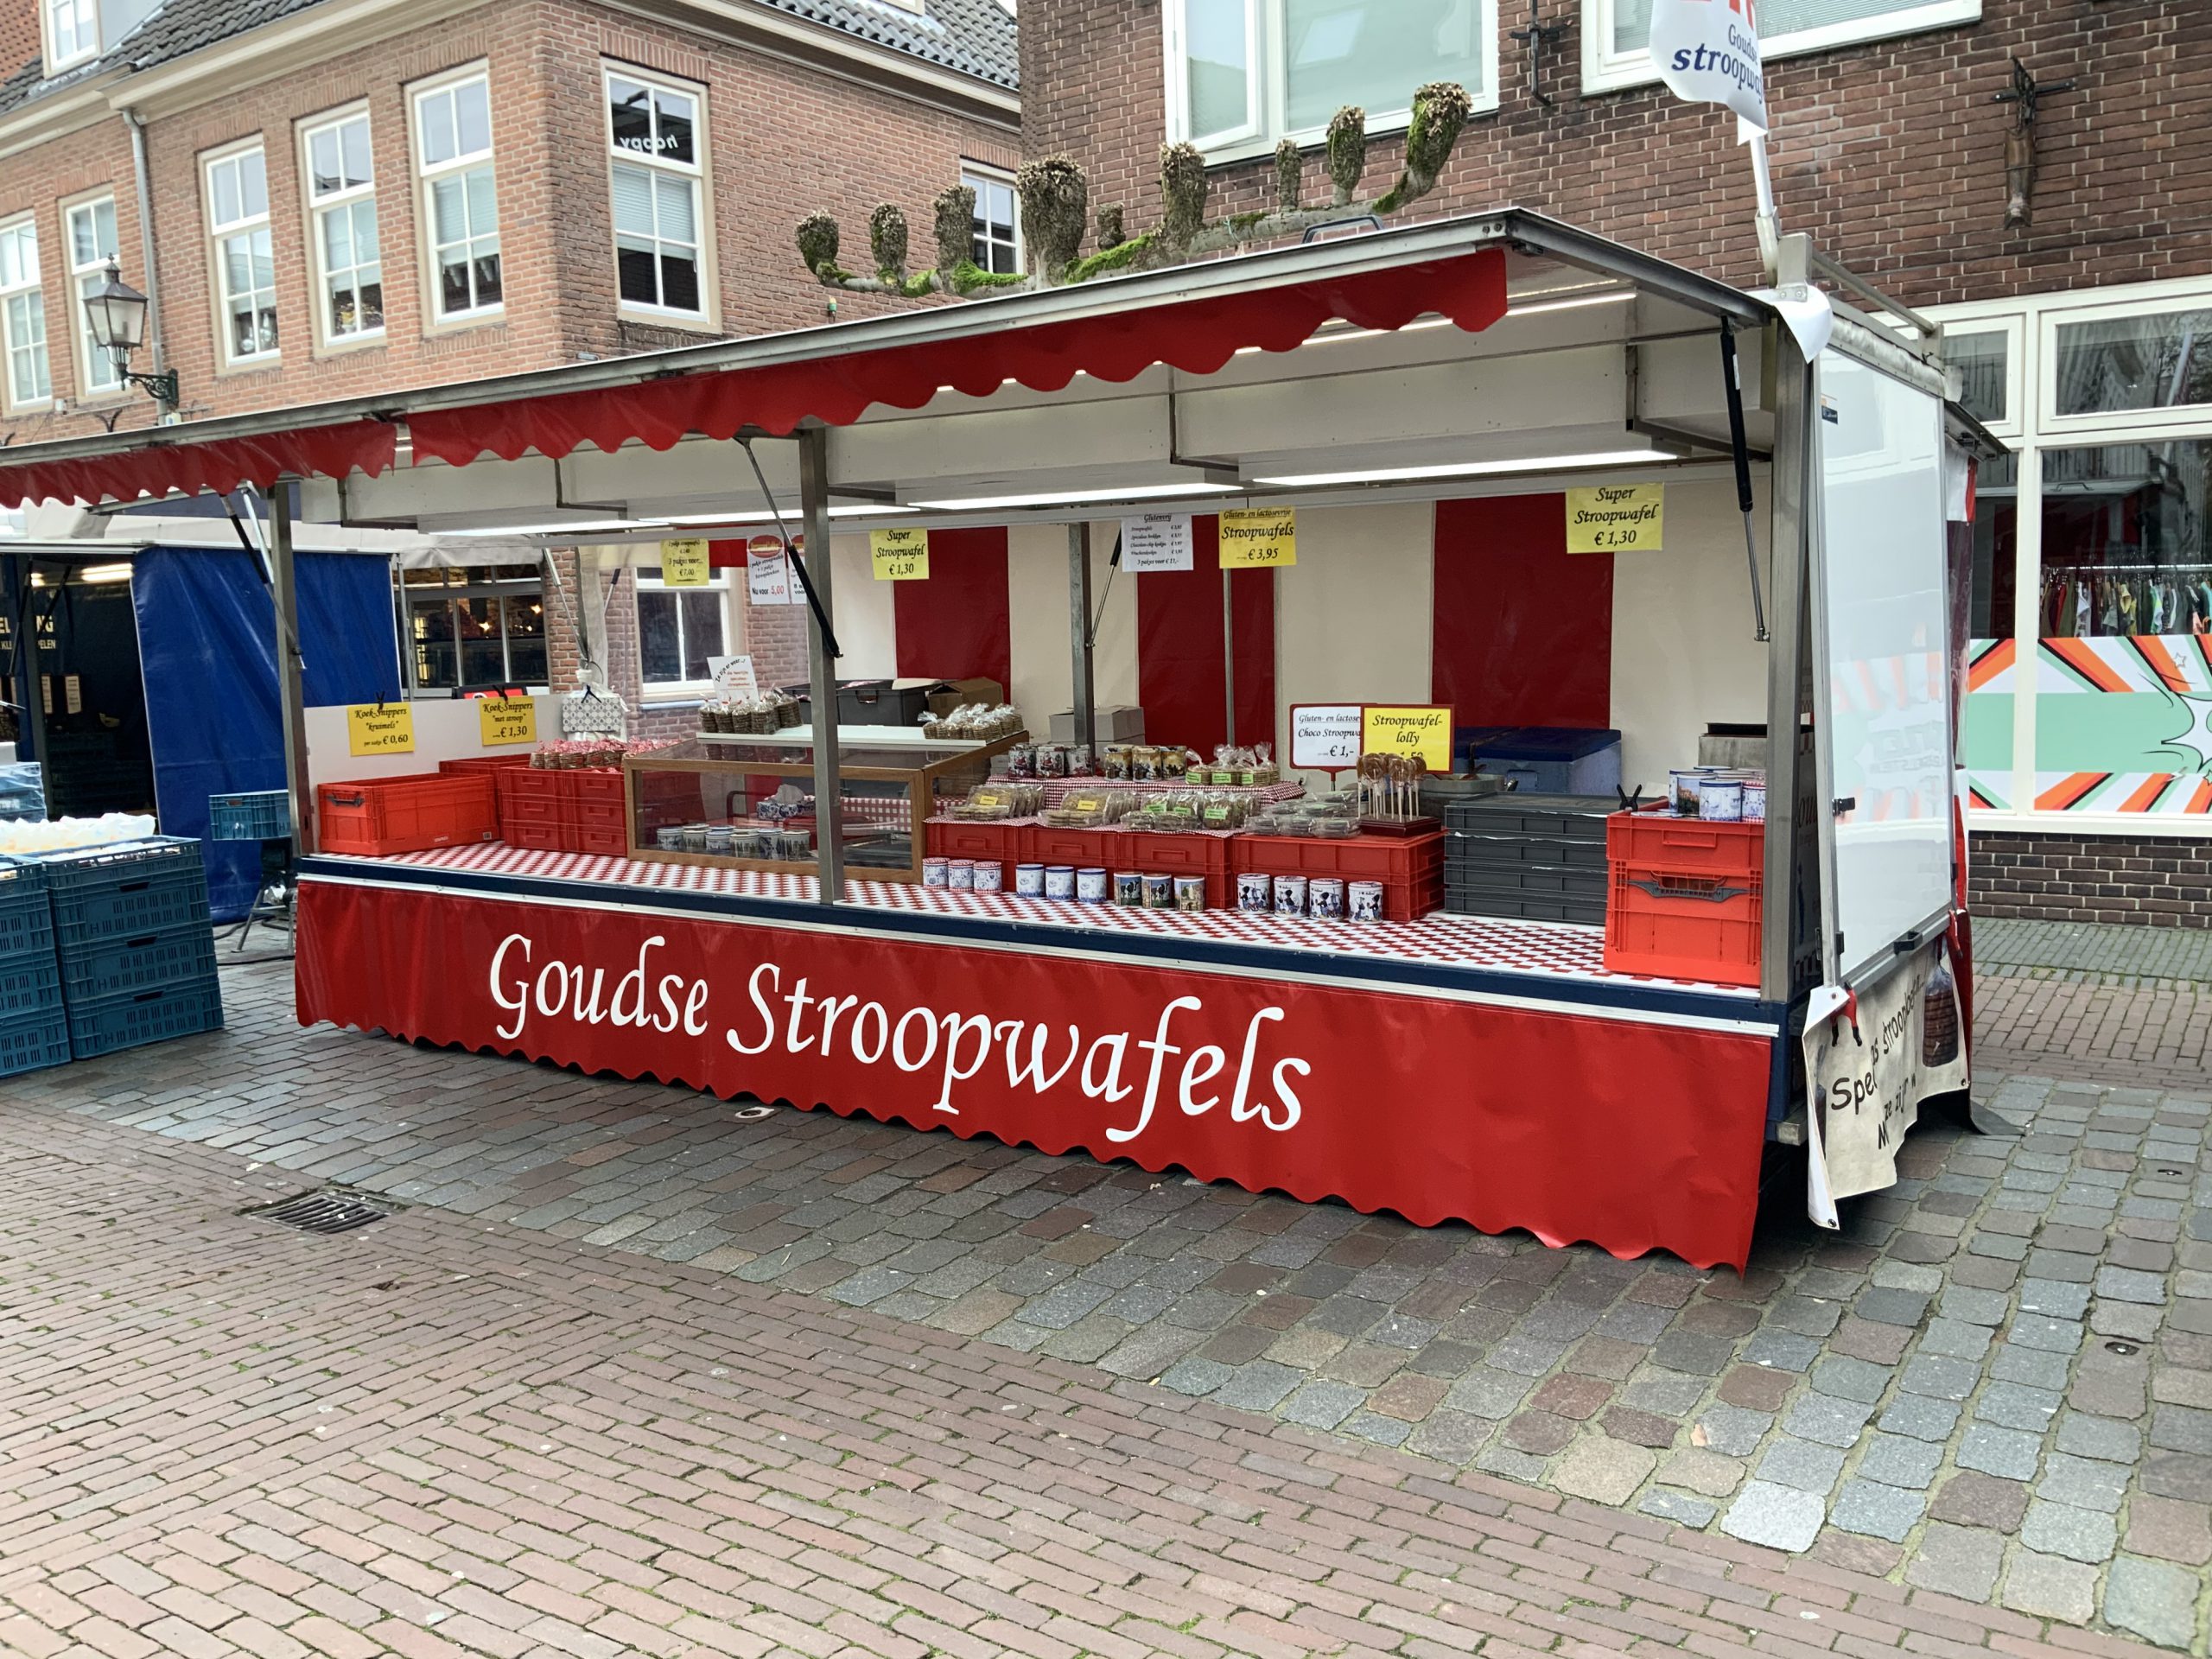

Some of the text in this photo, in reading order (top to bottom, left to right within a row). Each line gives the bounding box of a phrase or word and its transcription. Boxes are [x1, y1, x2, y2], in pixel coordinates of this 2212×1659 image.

[1595, 487, 1636, 505] Super
[1574, 504, 1659, 526] Stroopwafel
[887, 530, 912, 543] Super
[1221, 522, 1294, 541] Stroopwafels
[1594, 530, 1637, 547] € 1,30
[876, 543, 925, 560] Stroopwafel
[1249, 548, 1279, 561] € 3,95
[889, 563, 914, 576] € 1,30
[771, 585, 785, 595] 5,00
[1299, 714, 1325, 724] Gluten-
[1372, 715, 1443, 729] Stroopwafel-
[500, 725, 528, 738] € 1,30
[1298, 728, 1321, 738] Choco
[383, 735, 389, 745] €
[390, 734, 409, 744] 0,60
[1395, 731, 1420, 747] lolly
[1330, 746, 1338, 757] €
[490, 933, 1311, 1142] Goudse Stroopwafels
